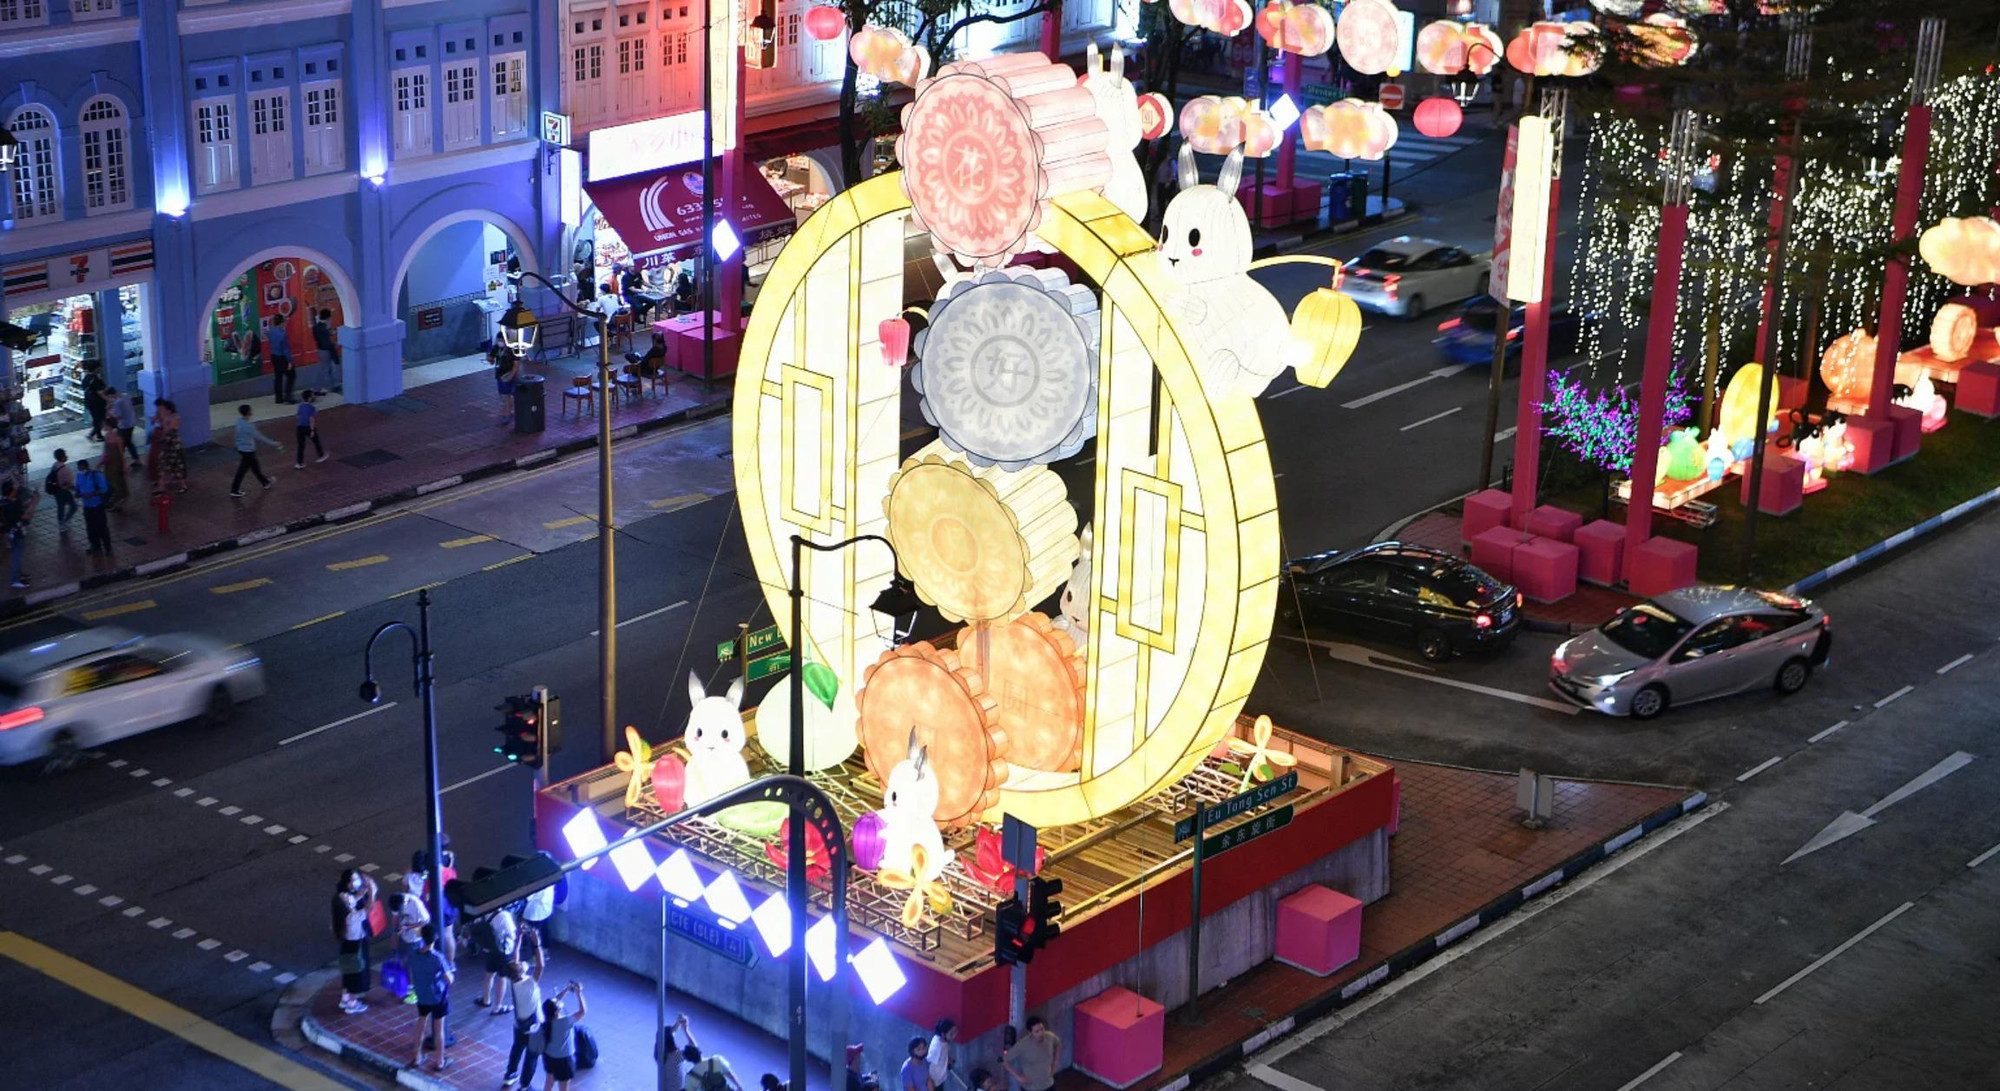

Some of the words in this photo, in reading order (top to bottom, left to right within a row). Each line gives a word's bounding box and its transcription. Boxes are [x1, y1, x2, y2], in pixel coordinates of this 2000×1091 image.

[954, 144, 987, 190] 花
[653, 231, 677, 242] UNION
[678, 227, 694, 236] GAS
[984, 348, 1028, 393] 好
[749, 633, 773, 648] New
[1207, 809, 1221, 823] Eu
[1226, 797, 1252, 815] Tong
[1257, 785, 1277, 801] Sen
[1282, 776, 1293, 791] St
[671, 911, 689, 930] CTE
[693, 920, 720, 945] (SLE)
